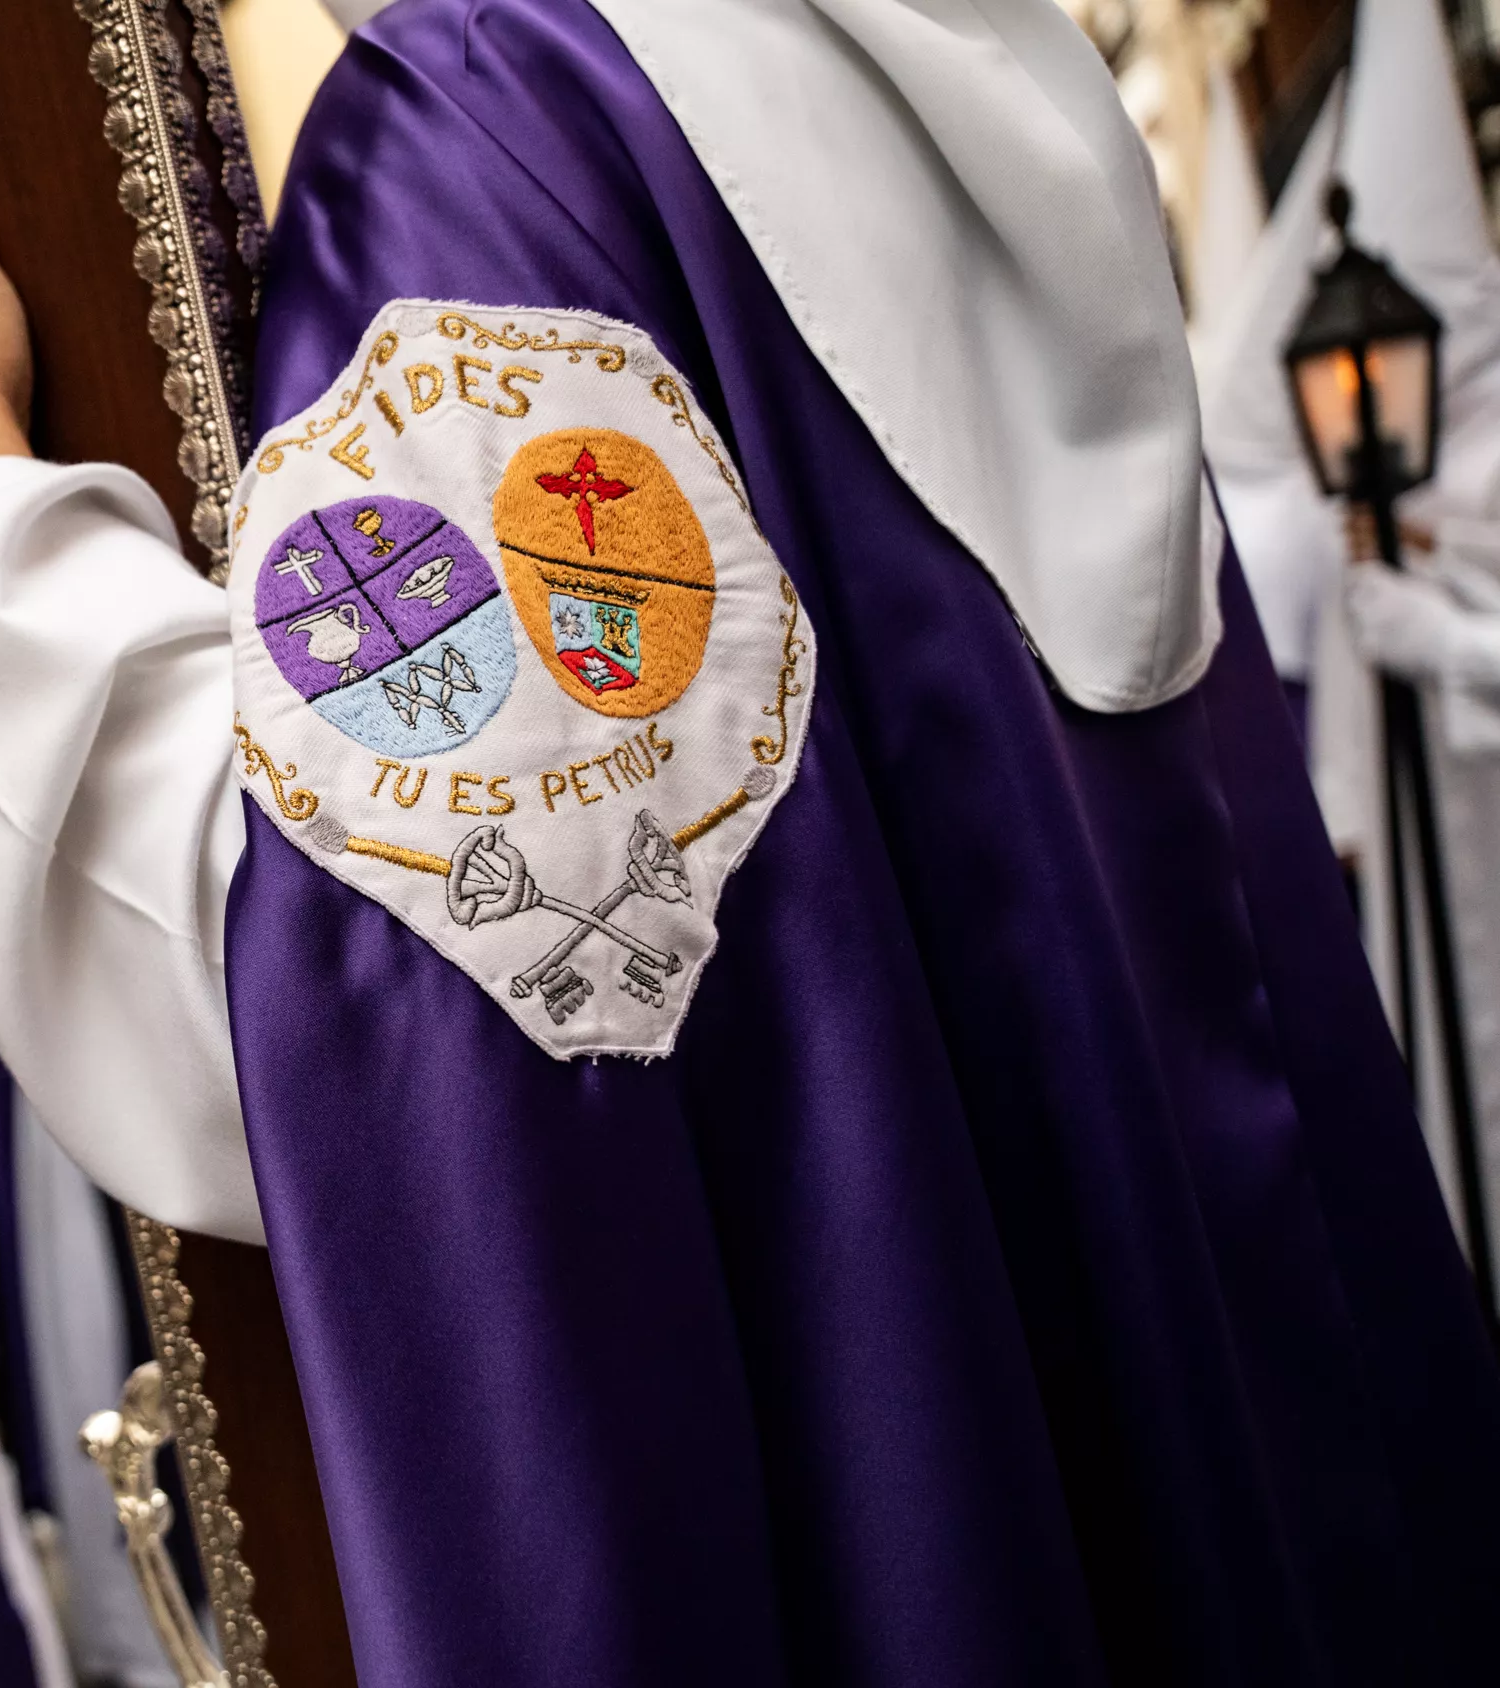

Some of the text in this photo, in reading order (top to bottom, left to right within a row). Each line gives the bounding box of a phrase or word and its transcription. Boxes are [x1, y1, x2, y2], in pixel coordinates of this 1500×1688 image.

[330, 354, 543, 480] FIDES
[370, 722, 674, 815] TU ES PETRUS
